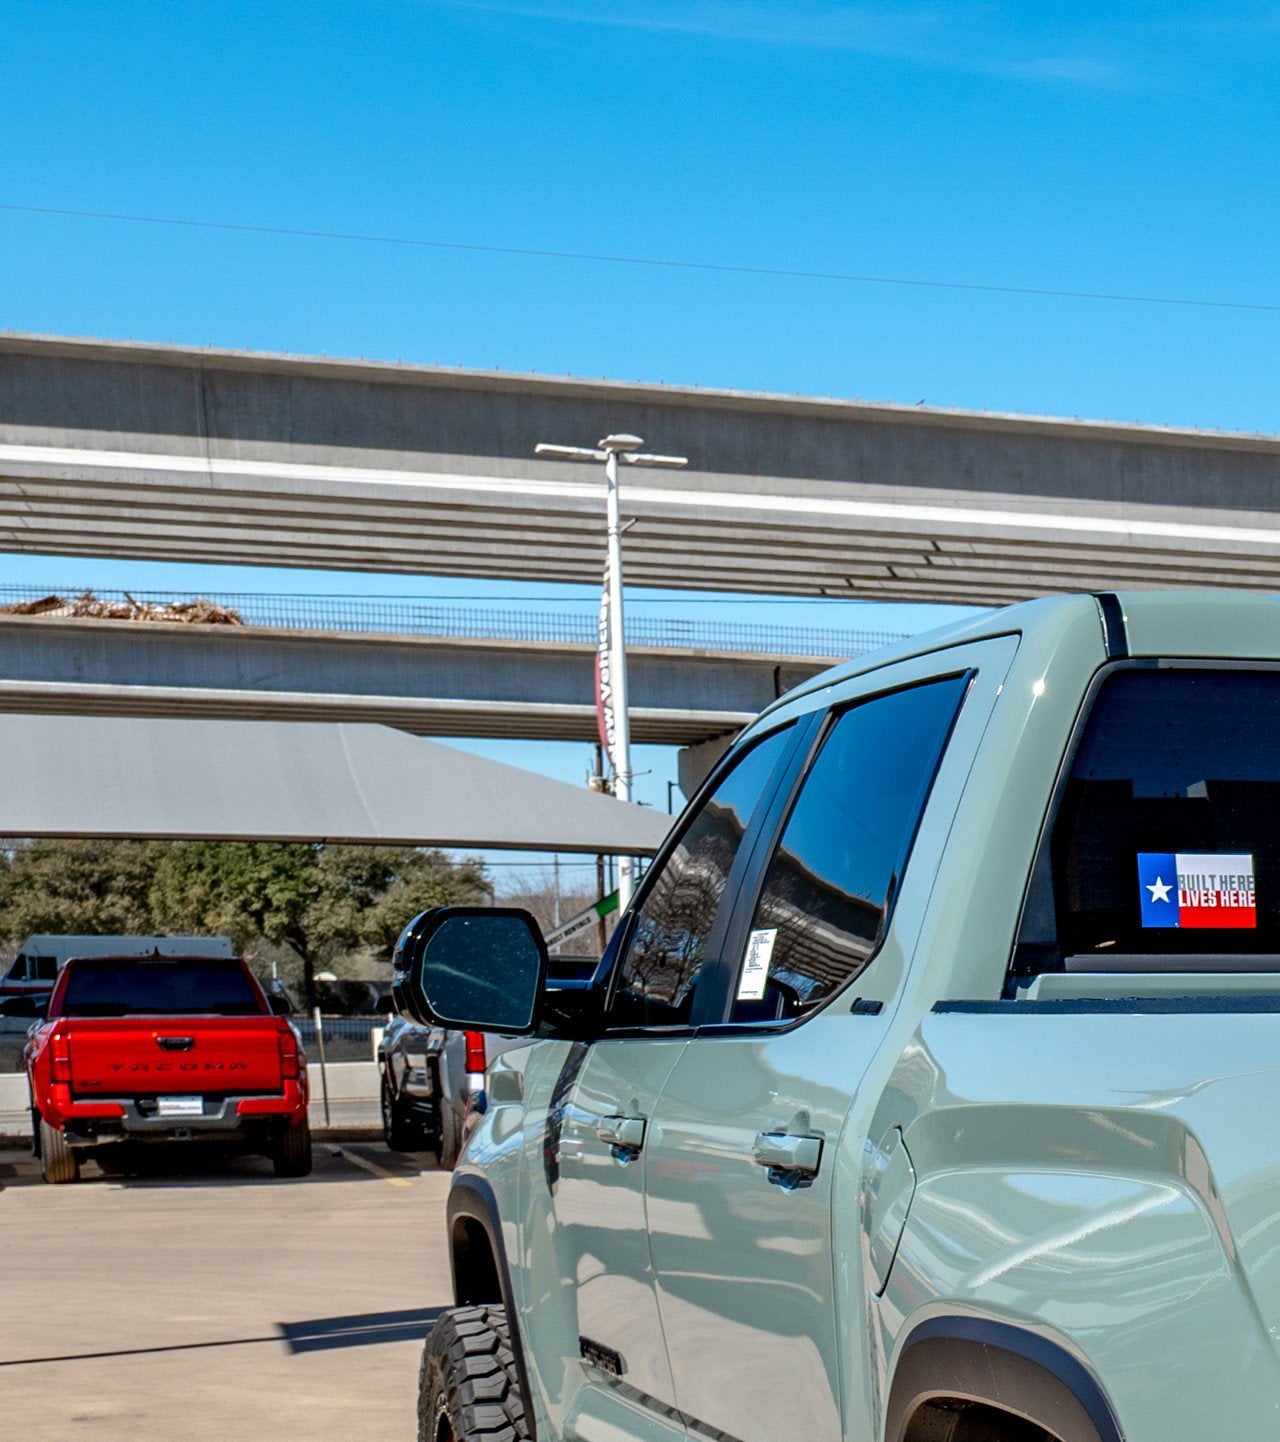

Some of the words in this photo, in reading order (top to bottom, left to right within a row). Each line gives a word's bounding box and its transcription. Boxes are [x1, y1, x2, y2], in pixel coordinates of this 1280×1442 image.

[1177, 874, 1217, 891] BUILT
[1219, 874, 1255, 891] HERE
[1178, 890, 1218, 908] LIVES
[1220, 890, 1256, 908] HERE
[110, 1063, 248, 1072] TACOMA
